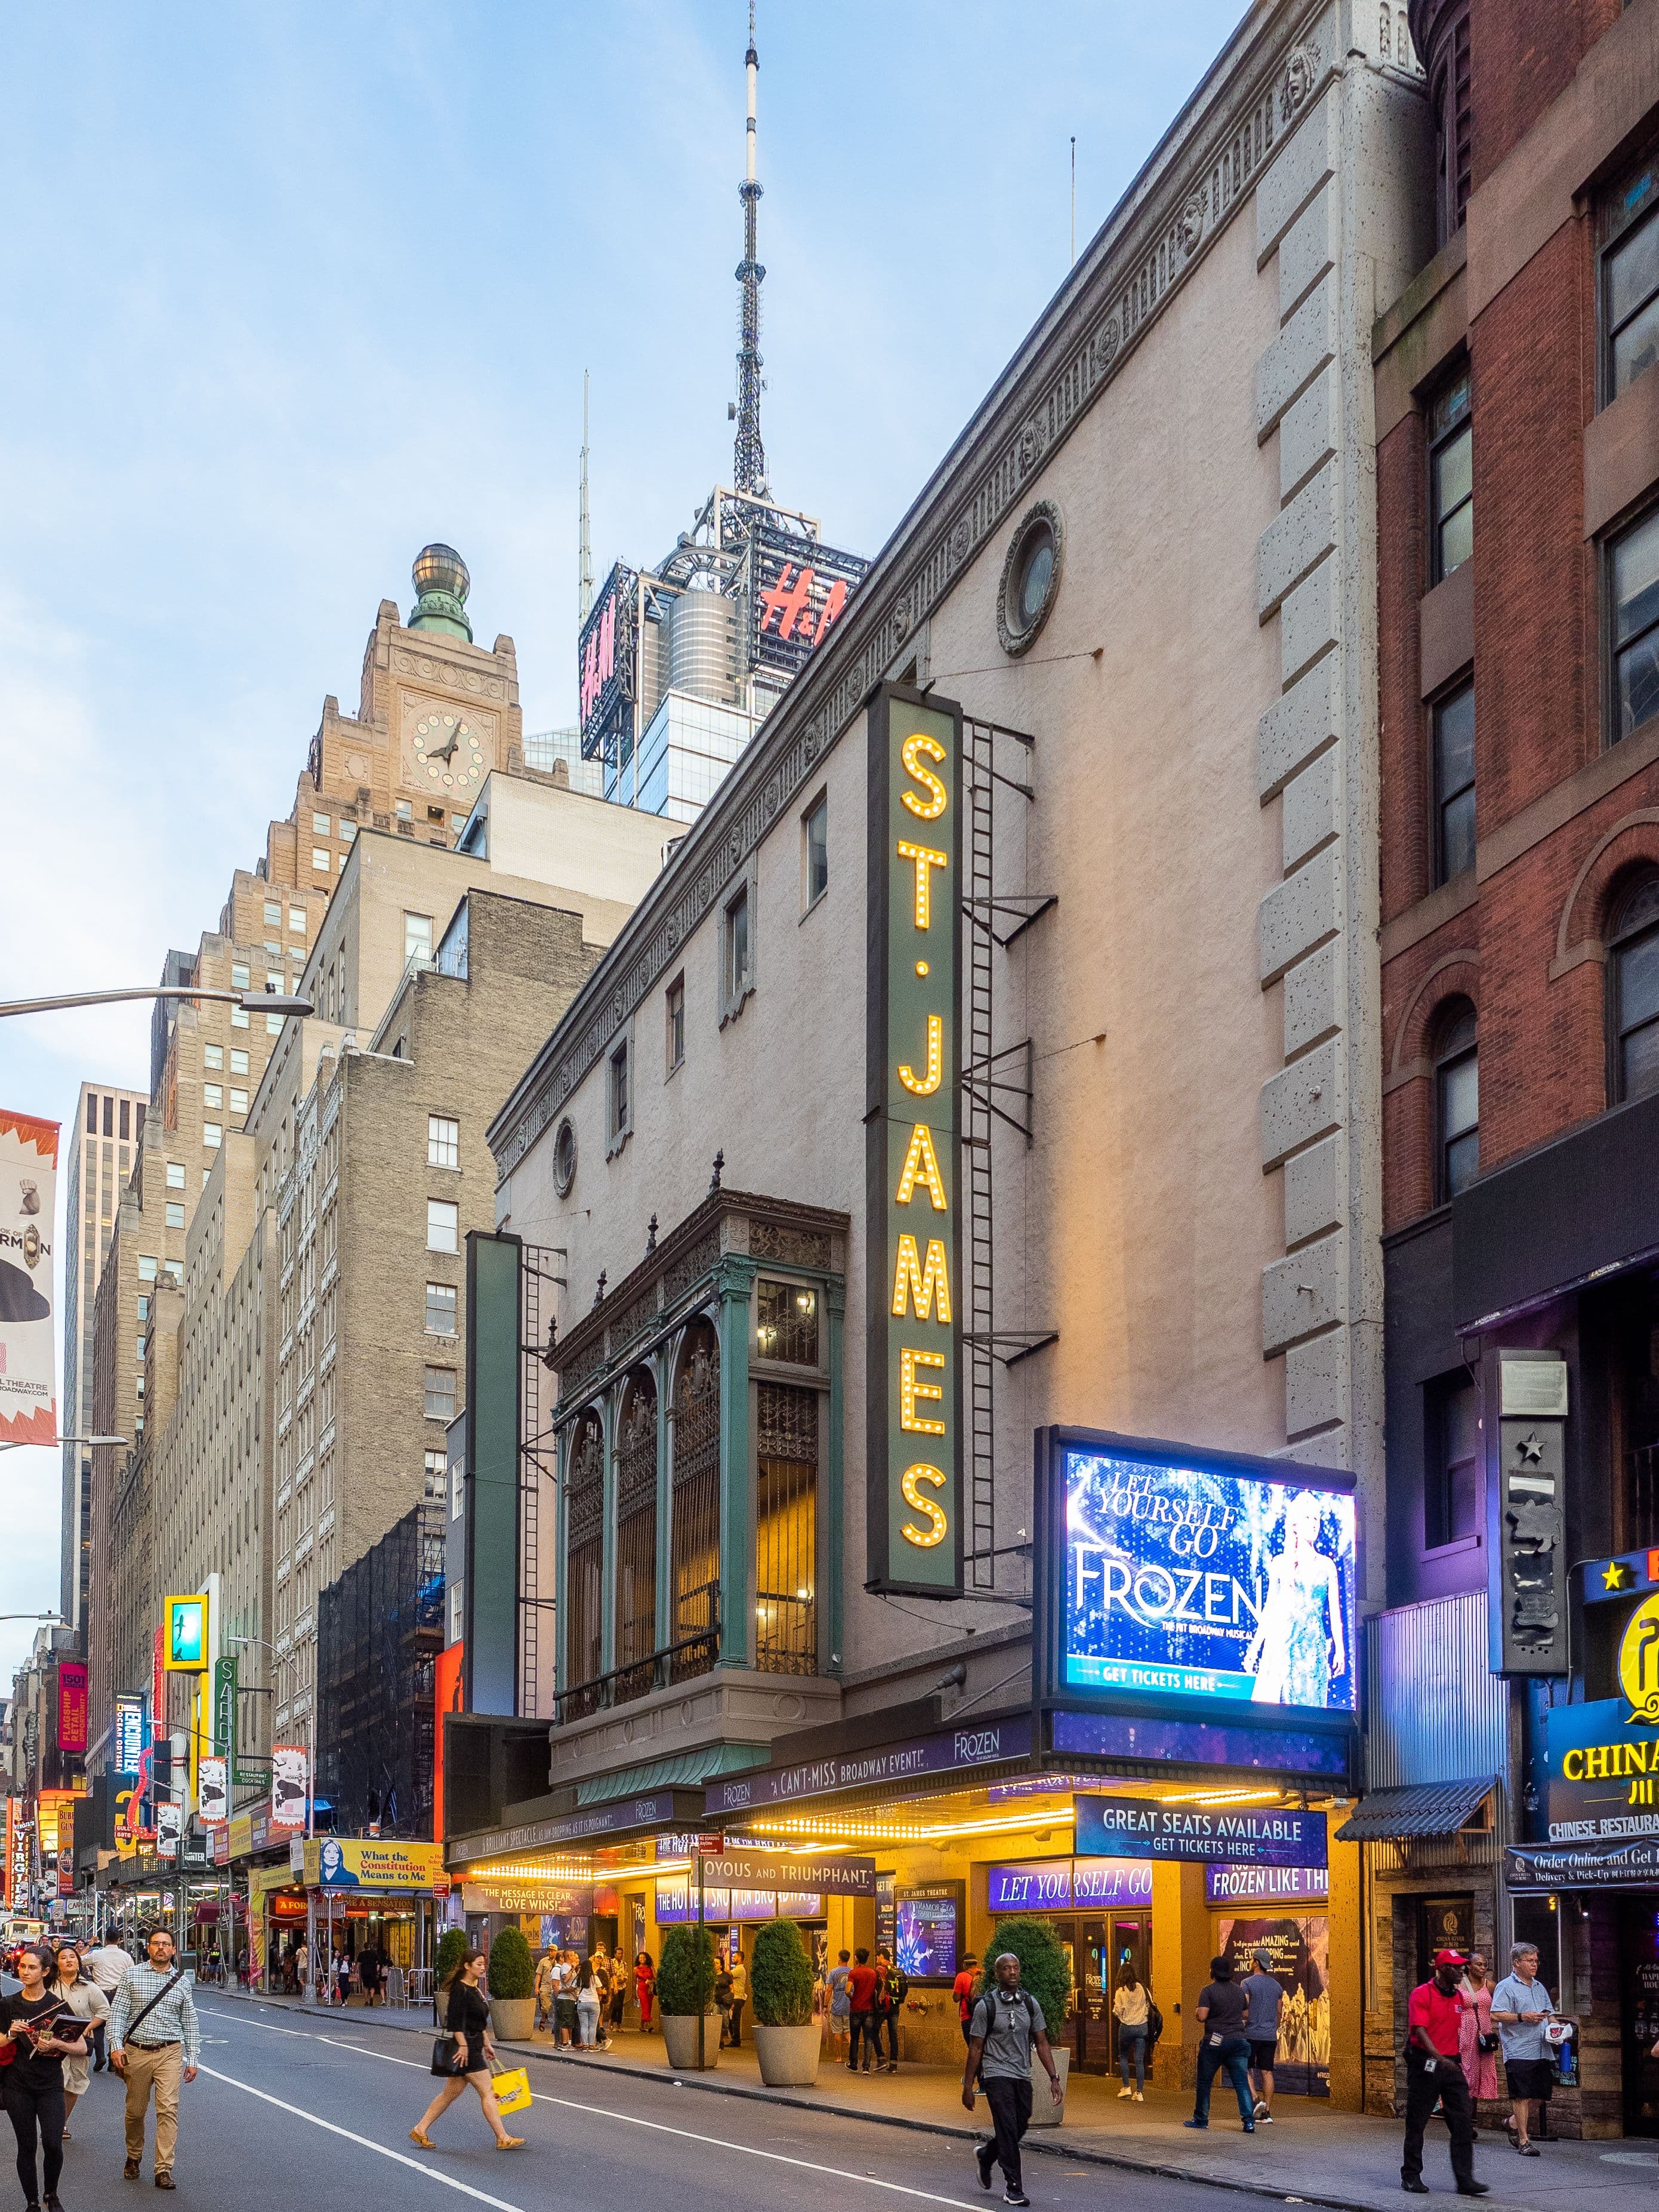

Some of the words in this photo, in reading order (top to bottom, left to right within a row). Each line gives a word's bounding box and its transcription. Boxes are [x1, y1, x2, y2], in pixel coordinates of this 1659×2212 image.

[6, 1379, 48, 1391] THEATRE
[1111, 1471, 1157, 1496] LET
[1100, 1487, 1239, 1531] YOURSELF
[1170, 1521, 1218, 1558] GO
[1074, 1542, 1266, 1629] FROZEN
[1161, 1621, 1175, 1631] THE
[1176, 1622, 1188, 1632] HIT
[1188, 1623, 1225, 1637] BROADWAY
[1226, 1628, 1253, 1640] MUSICAL
[1103, 1666, 1127, 1683] GET
[1131, 1669, 1181, 1689] TICKETS
[1184, 1674, 1216, 1692] HERE
[63, 1691, 71, 1741] FLAGSHIP
[124, 1712, 142, 1773] ENCOUNTER
[954, 1728, 1000, 1762] FROZEN
[781, 1760, 835, 1793] CAN'T-MISS
[841, 1757, 886, 1782] BROADWAY
[723, 1782, 750, 1807] FROZEN
[636, 1800, 656, 1822] FROZEN
[1103, 1809, 1158, 1832] GREAT
[1162, 1812, 1212, 1836] SEATS
[1216, 1816, 1302, 1842] AVAILABLE
[1548, 1820, 1596, 1838] CHINESE
[1600, 1813, 1659, 1835] RESTAURA
[486, 1834, 509, 1853] BRILLIANT
[572, 1825, 578, 1833] AS
[1154, 1837, 1176, 1851] GET
[1179, 1839, 1223, 1854] TICKETS
[1227, 1842, 1256, 1856] HERE
[360, 1851, 390, 1861] What
[392, 1851, 408, 1862] the
[360, 1860, 426, 1872] Constitution
[1534, 1853, 1566, 1869] Order
[1568, 1852, 1604, 1868] Online
[1606, 1850, 1627, 1865] and
[1631, 1849, 1651, 1864] Get
[360, 1869, 394, 1880] Means
[397, 1872, 409, 1880] to
[411, 1871, 425, 1881] Me
[756, 1868, 776, 1879] AND
[1000, 1877, 1033, 1902] LET
[1037, 1869, 1127, 1900] YOURSELF
[1129, 1866, 1152, 1895] GO
[1213, 1870, 1265, 1896] FROZEN
[1269, 1868, 1300, 1892] LIKE
[1305, 1868, 1328, 1890] THI
[1535, 1870, 1566, 1881] Delivery
[1568, 1871, 1574, 1880] &
[1577, 1869, 1609, 1881] Pick-Up
[481, 1888, 499, 1897] "THE
[501, 1890, 536, 1899] MESSAGE
[538, 1891, 545, 1899] IS
[876, 1880, 885, 1892] GET
[280, 1901, 287, 1909] A
[499, 1899, 526, 1910] LOVE
[671, 1887, 708, 1910] HOTTET
[711, 1888, 739, 1908] SNOW
[635, 1903, 645, 1923] FRO
[1261, 1934, 1288, 1946] AMAZING
